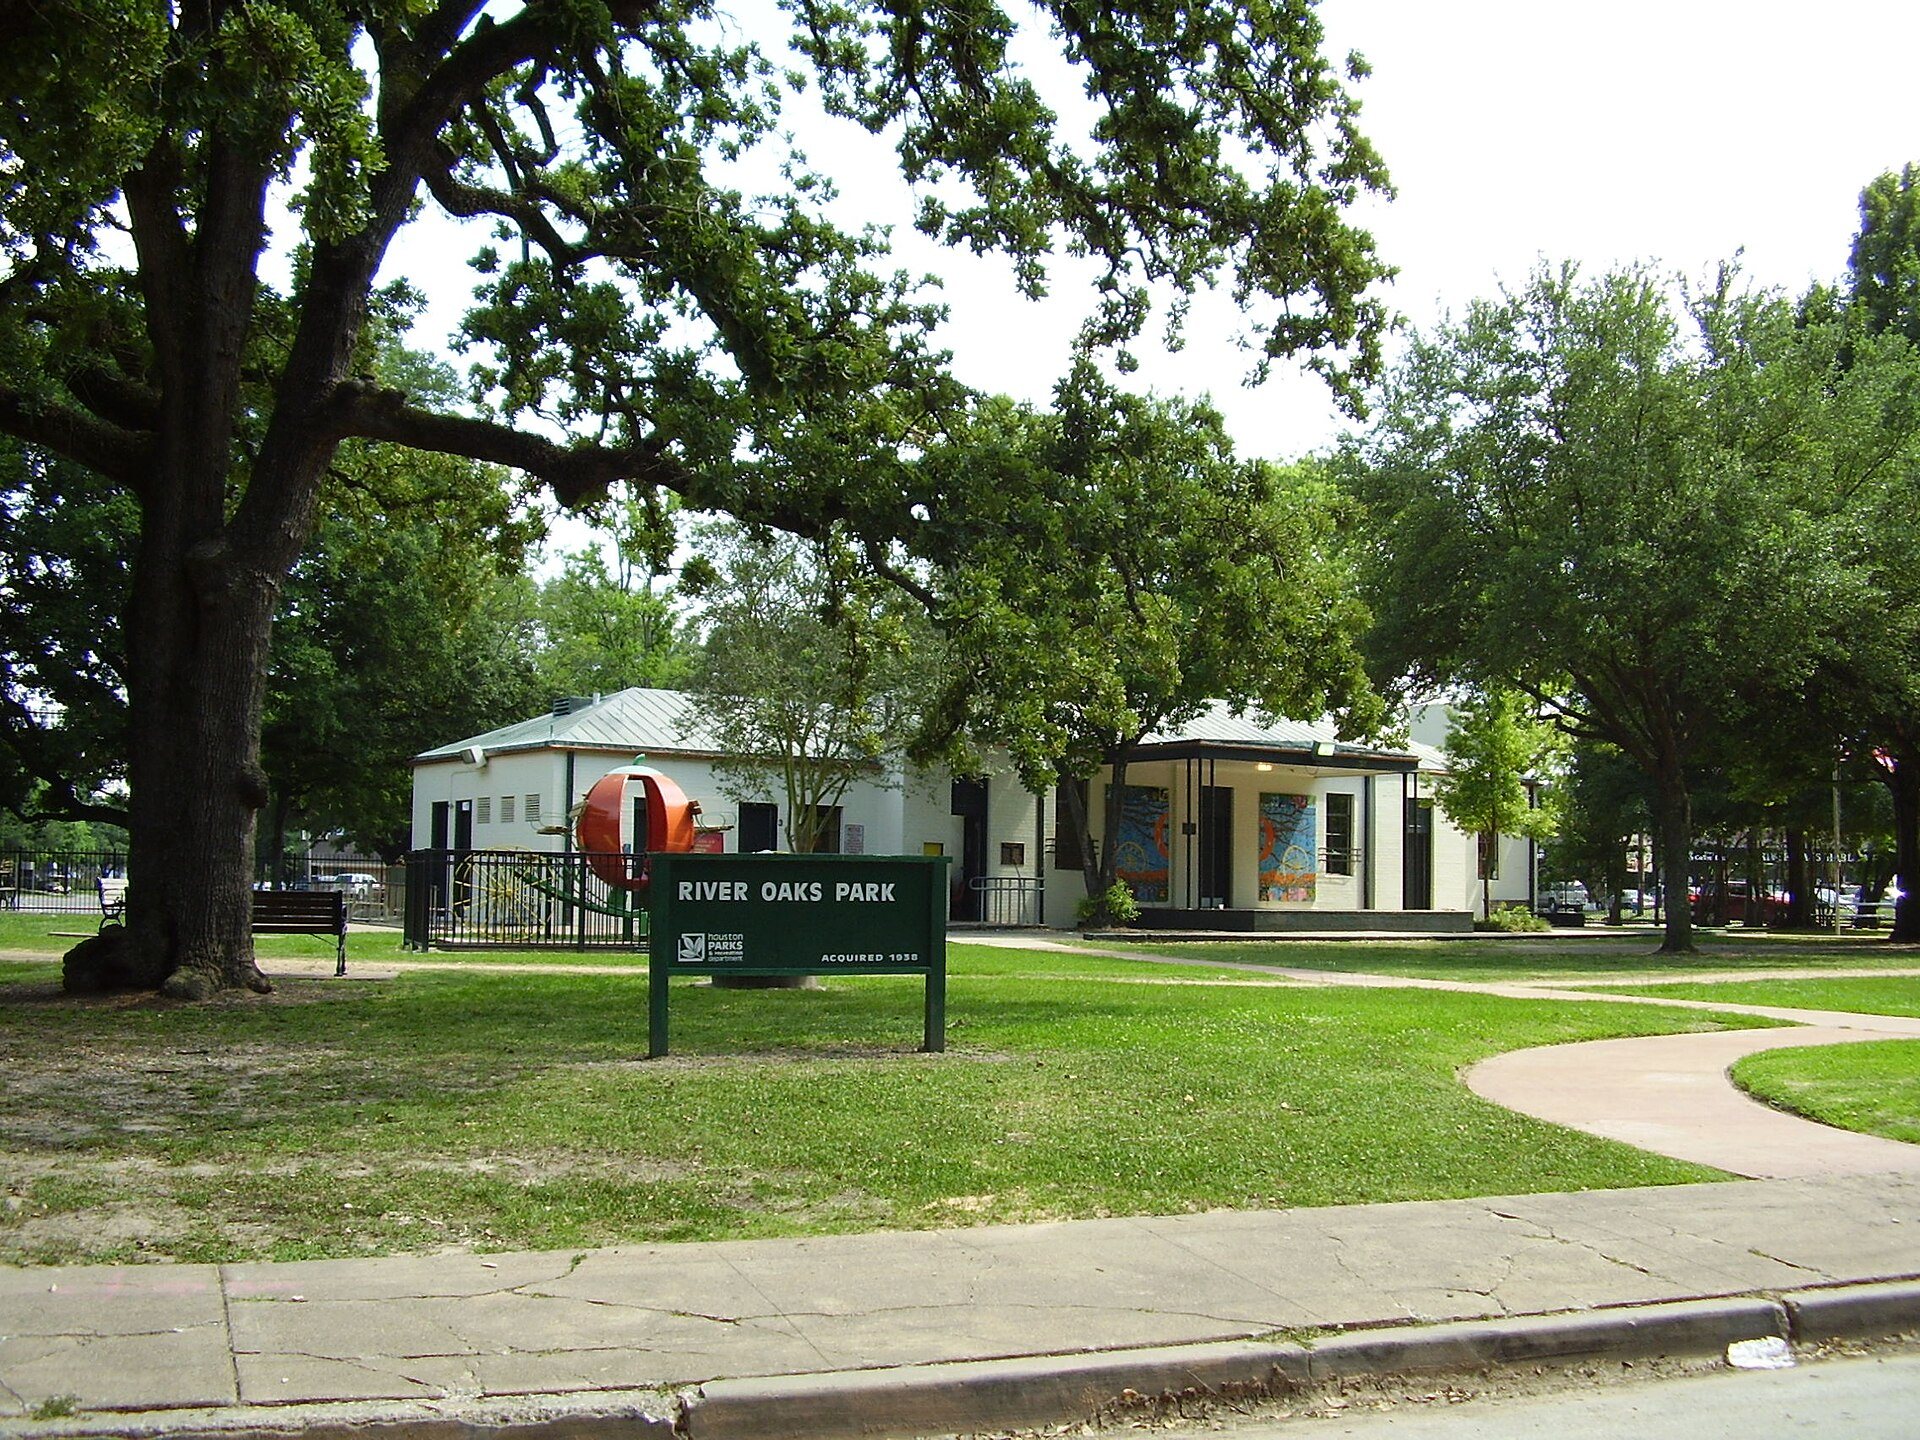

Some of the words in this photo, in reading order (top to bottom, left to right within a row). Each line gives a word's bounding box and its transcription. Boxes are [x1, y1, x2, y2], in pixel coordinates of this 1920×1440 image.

[678, 881, 749, 901] RIVER
[761, 881, 823, 902] OAKS
[835, 882, 896, 902] PARK
[708, 932, 744, 941] houston
[708, 941, 744, 951] PARKS
[821, 954, 884, 962] ACQUIRED
